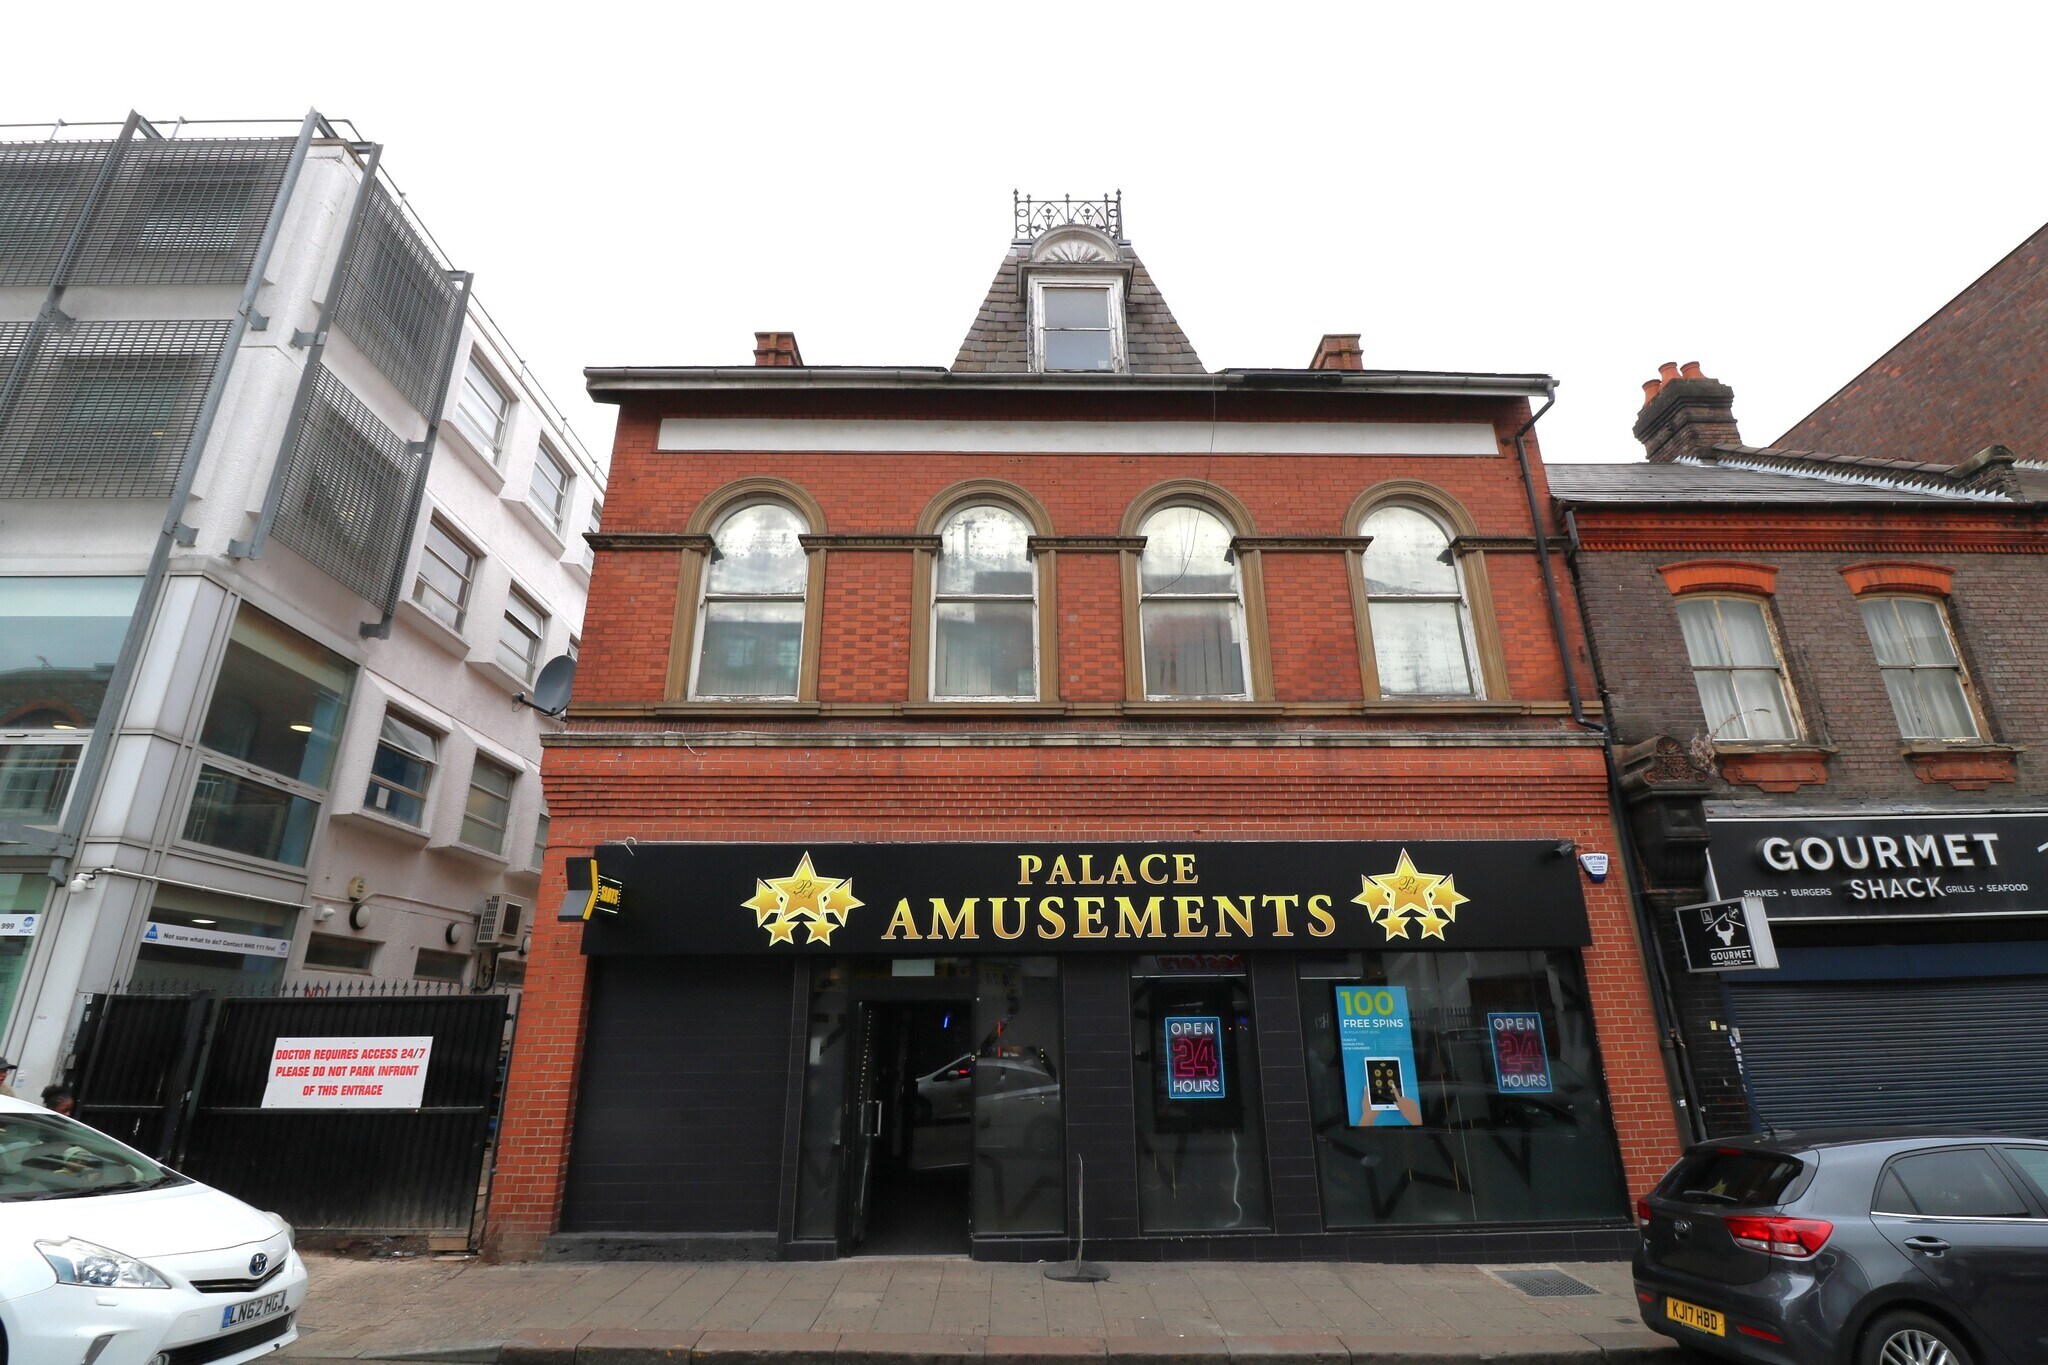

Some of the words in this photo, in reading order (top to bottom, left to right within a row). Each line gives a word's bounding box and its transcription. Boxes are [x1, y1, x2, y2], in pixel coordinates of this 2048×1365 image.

[1761, 833, 2000, 872] GOURMET
[1017, 853, 1199, 885] PALACE
[600, 885, 620, 905] SLOTS
[1743, 889, 1779, 898] SHAKES
[1791, 887, 1832, 897] BURGERS
[1849, 876, 1947, 901] SHACK
[1945, 884, 1976, 894] GRILLS
[1986, 883, 2029, 893] SEAFOOD
[880, 893, 1336, 940] AMUSEMENTS
[1, 922, 15, 930] 999
[163, 932, 175, 940] Not
[223, 940, 243, 948] Contact
[1710, 949, 1752, 961] GOURMET
[1340, 991, 1394, 1016] 100
[1170, 1022, 1214, 1035] OPEN
[1343, 1019, 1371, 1028] FREE
[1372, 1019, 1404, 1028] SPINS
[1493, 1017, 1536, 1031] OPEN
[275, 1049, 311, 1060] DOCTOR
[313, 1049, 359, 1061] REQUIRES
[361, 1049, 398, 1060] ACCESS
[400, 1048, 426, 1060] 24/7
[1172, 1037, 1218, 1077] 24
[1497, 1032, 1543, 1072] 24
[275, 1066, 310, 1077] PLEASE
[312, 1066, 326, 1077] DO
[328, 1066, 348, 1077] NOT
[350, 1066, 376, 1077] PARK
[378, 1065, 419, 1076] INFRONT
[1173, 1080, 1220, 1093] HOURS
[1501, 1074, 1548, 1088] HOURS
[302, 1085, 315, 1096] OF
[317, 1085, 339, 1096] THIS
[341, 1084, 384, 1096] ENTRACE
[229, 1300, 263, 1324] LN62
[264, 1291, 287, 1314] HGJ
[1672, 1301, 1694, 1323] KJ17
[1696, 1308, 1718, 1331] HBD
